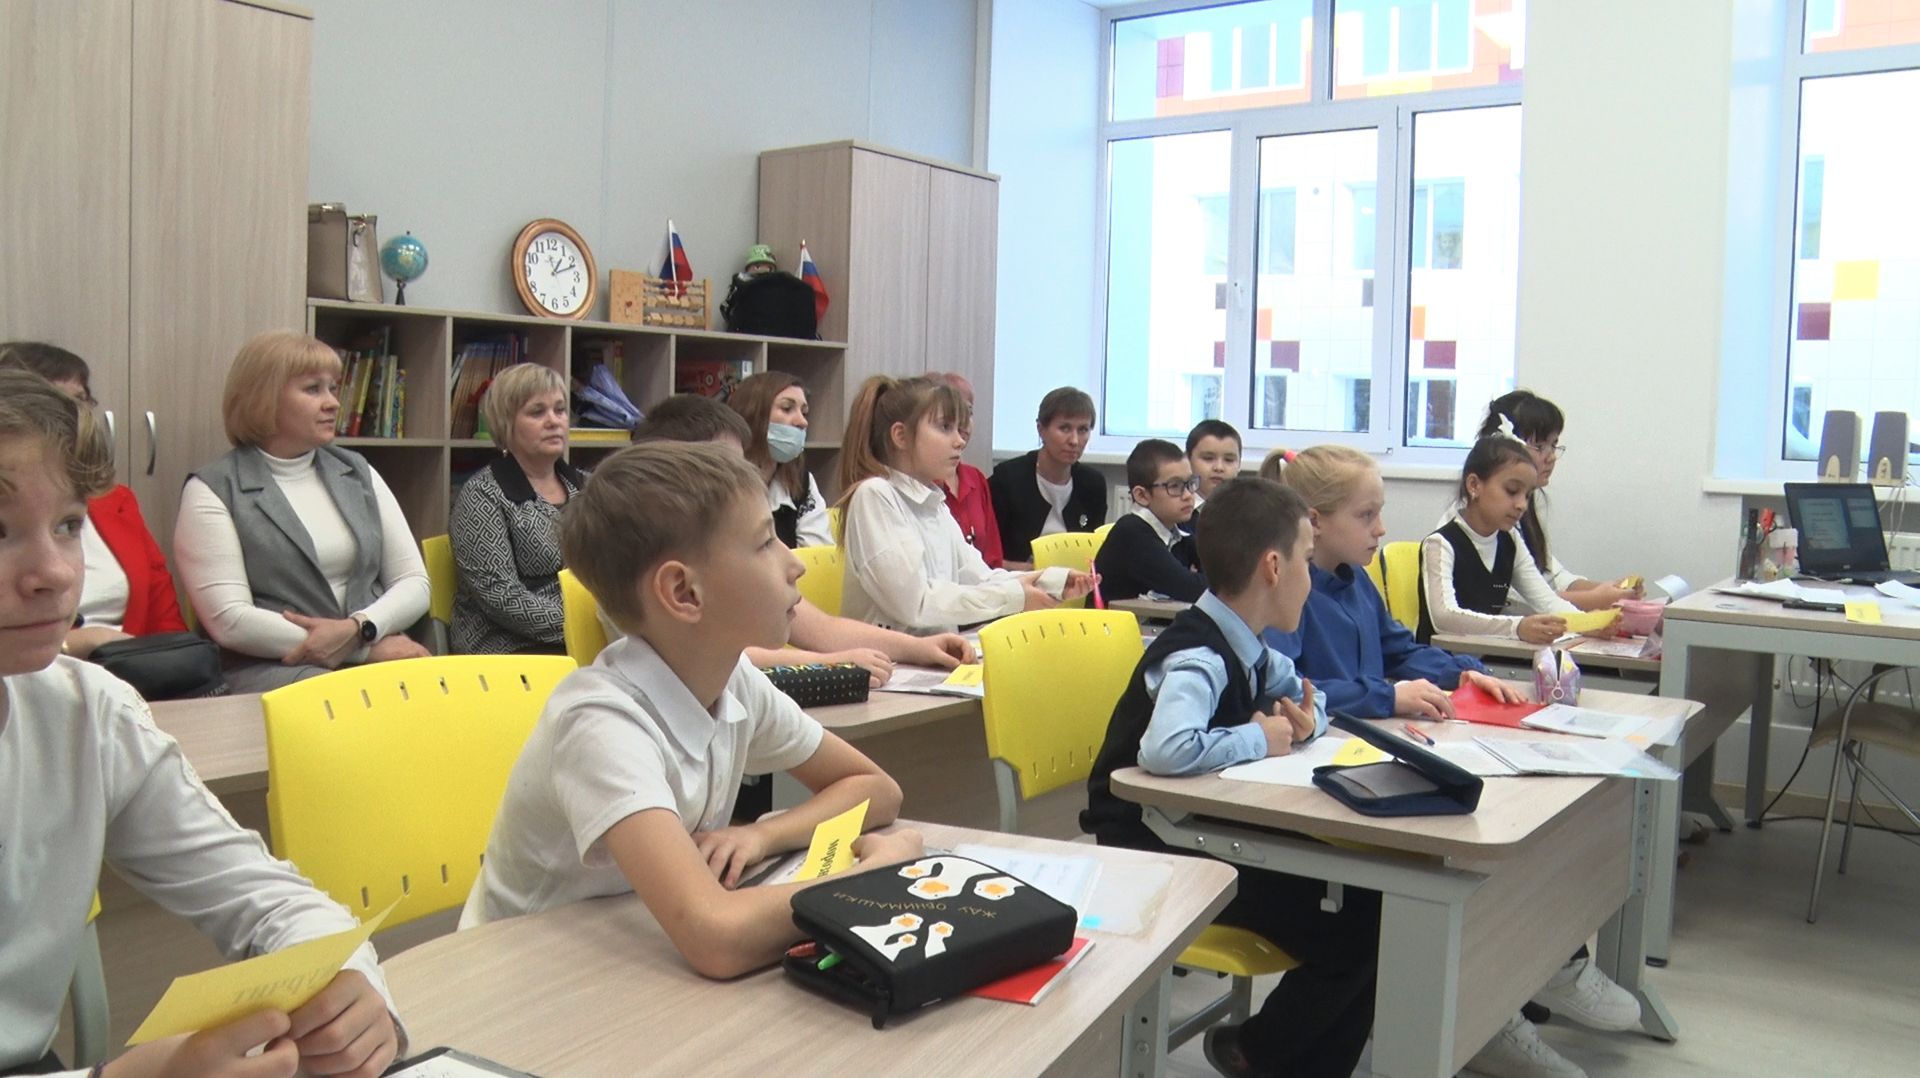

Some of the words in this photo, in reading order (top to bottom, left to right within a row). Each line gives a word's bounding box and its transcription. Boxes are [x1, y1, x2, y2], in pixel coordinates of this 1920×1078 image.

[535, 241, 545, 254] 11
[546, 238, 558, 251] 12
[561, 245, 566, 257] 1
[527, 252, 539, 265] 10
[568, 255, 576, 268] 2
[573, 271, 580, 283] 3
[530, 281, 537, 293] 8
[570, 286, 577, 298] 4
[540, 293, 546, 306] 7
[551, 298, 559, 310] 6
[562, 296, 569, 308] 5
[832, 891, 948, 911] ОБНИМАШКИ
